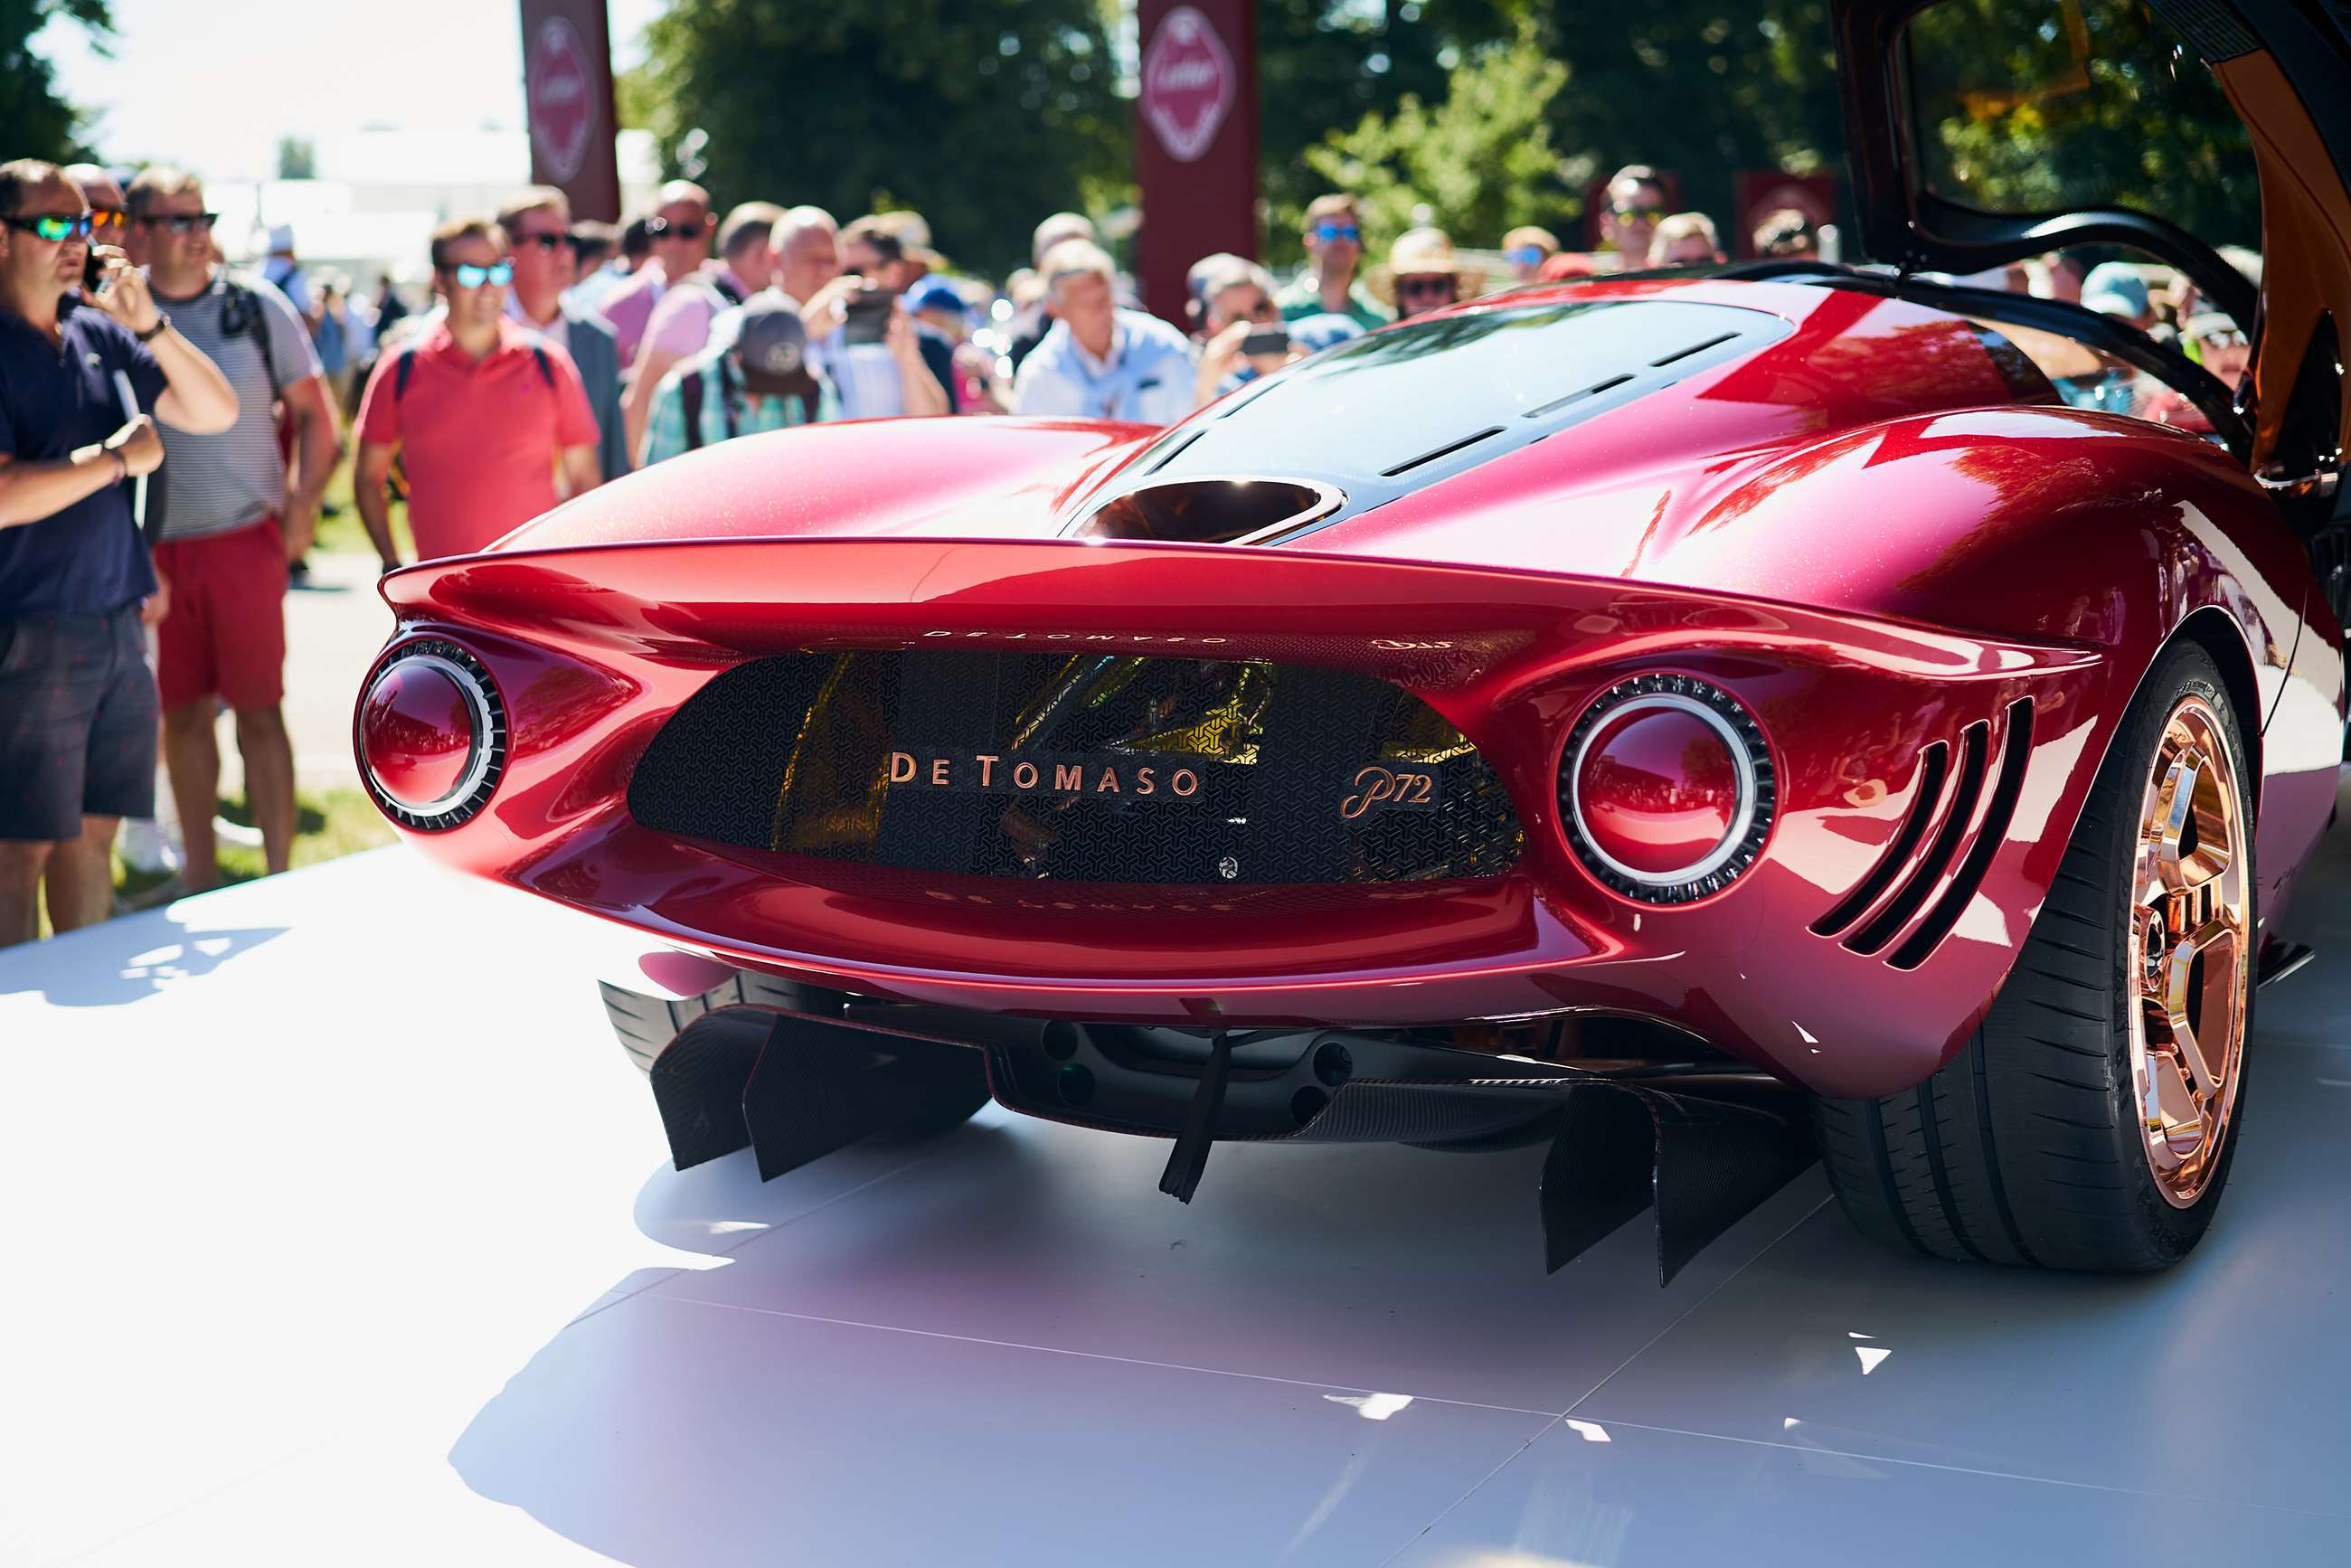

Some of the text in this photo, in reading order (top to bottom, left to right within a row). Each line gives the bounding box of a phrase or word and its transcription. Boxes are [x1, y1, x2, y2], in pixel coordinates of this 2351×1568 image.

[890, 751, 1199, 797] DE TOMASO
[1339, 765, 1433, 819] P72
